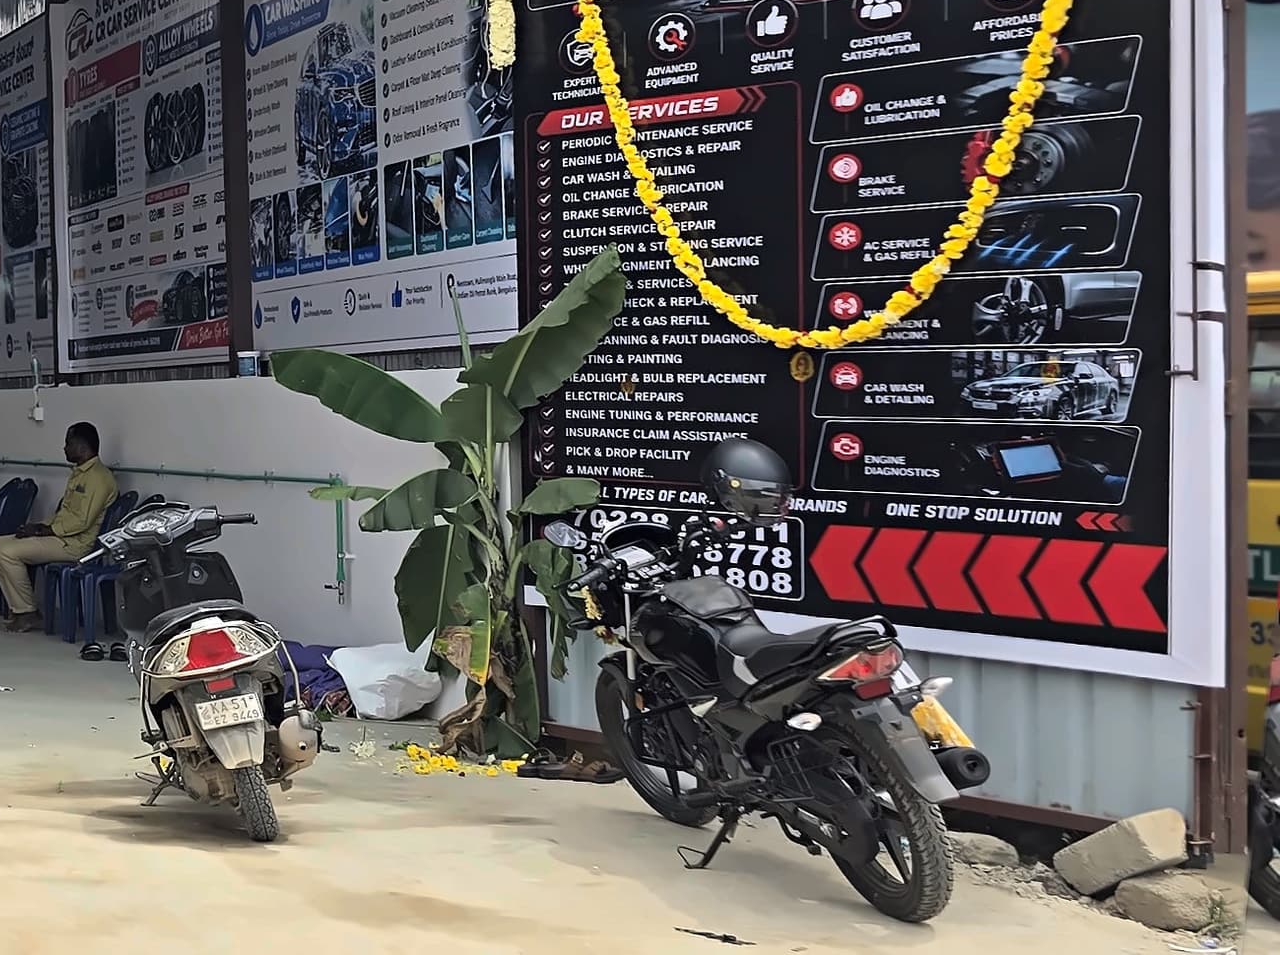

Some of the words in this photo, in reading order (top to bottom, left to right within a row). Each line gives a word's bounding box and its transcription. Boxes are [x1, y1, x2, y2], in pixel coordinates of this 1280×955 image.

[159, 28, 182, 53] ALLOY
[183, 10, 214, 39] WHEELS
[990, 28, 1034, 42] PRICES
[849, 32, 912, 49] CUSTOMER
[750, 49, 794, 63] QUALITY
[842, 42, 920, 62] SATISFACTION
[647, 63, 697, 77] ADVANCED
[751, 60, 794, 74] SERVICE
[564, 76, 597, 88] EXPERT
[645, 73, 699, 89] EQUIPMENT
[885, 96, 934, 112] CHANGE
[864, 108, 940, 126] LUBRICATION
[561, 136, 612, 150] PERIODIC
[702, 120, 753, 135] SERVICE
[562, 153, 602, 167] ENGINE
[697, 140, 741, 153] REPAIR
[587, 171, 620, 183] WASH
[858, 175, 896, 187] BRAKE
[583, 188, 630, 201] CHANGE
[858, 185, 905, 198] SERVICE
[563, 209, 599, 221] BRAKE
[563, 227, 607, 239] CLUTCH
[609, 224, 657, 236] SERVICE
[711, 236, 764, 248] SERVICE
[880, 238, 930, 249] SERVICE
[643, 316, 668, 326] GAS
[670, 316, 710, 326] REFILL
[662, 334, 698, 344] FAULT
[627, 354, 683, 364] PAINTING
[643, 373, 674, 383] BULB
[677, 374, 767, 384] REPLACEMENT
[565, 392, 632, 402] ELECTRICAL
[635, 392, 684, 402] REPAIRS
[875, 394, 934, 405] DETAILING
[608, 410, 652, 420] TUNING
[667, 411, 759, 424] PERFORMANCE
[565, 428, 630, 439] INSURANCE
[633, 430, 670, 440] CLAIM
[640, 449, 690, 461] FACILITY
[577, 465, 609, 476] MANY
[864, 467, 940, 478] DIAGNOSTICS
[614, 487, 656, 501] TYPES
[886, 503, 919, 518] ONE
[924, 505, 970, 520] STOP
[973, 508, 1062, 527] SOLUTION
[210, 702, 228, 714] KA
[231, 697, 248, 709] 51
